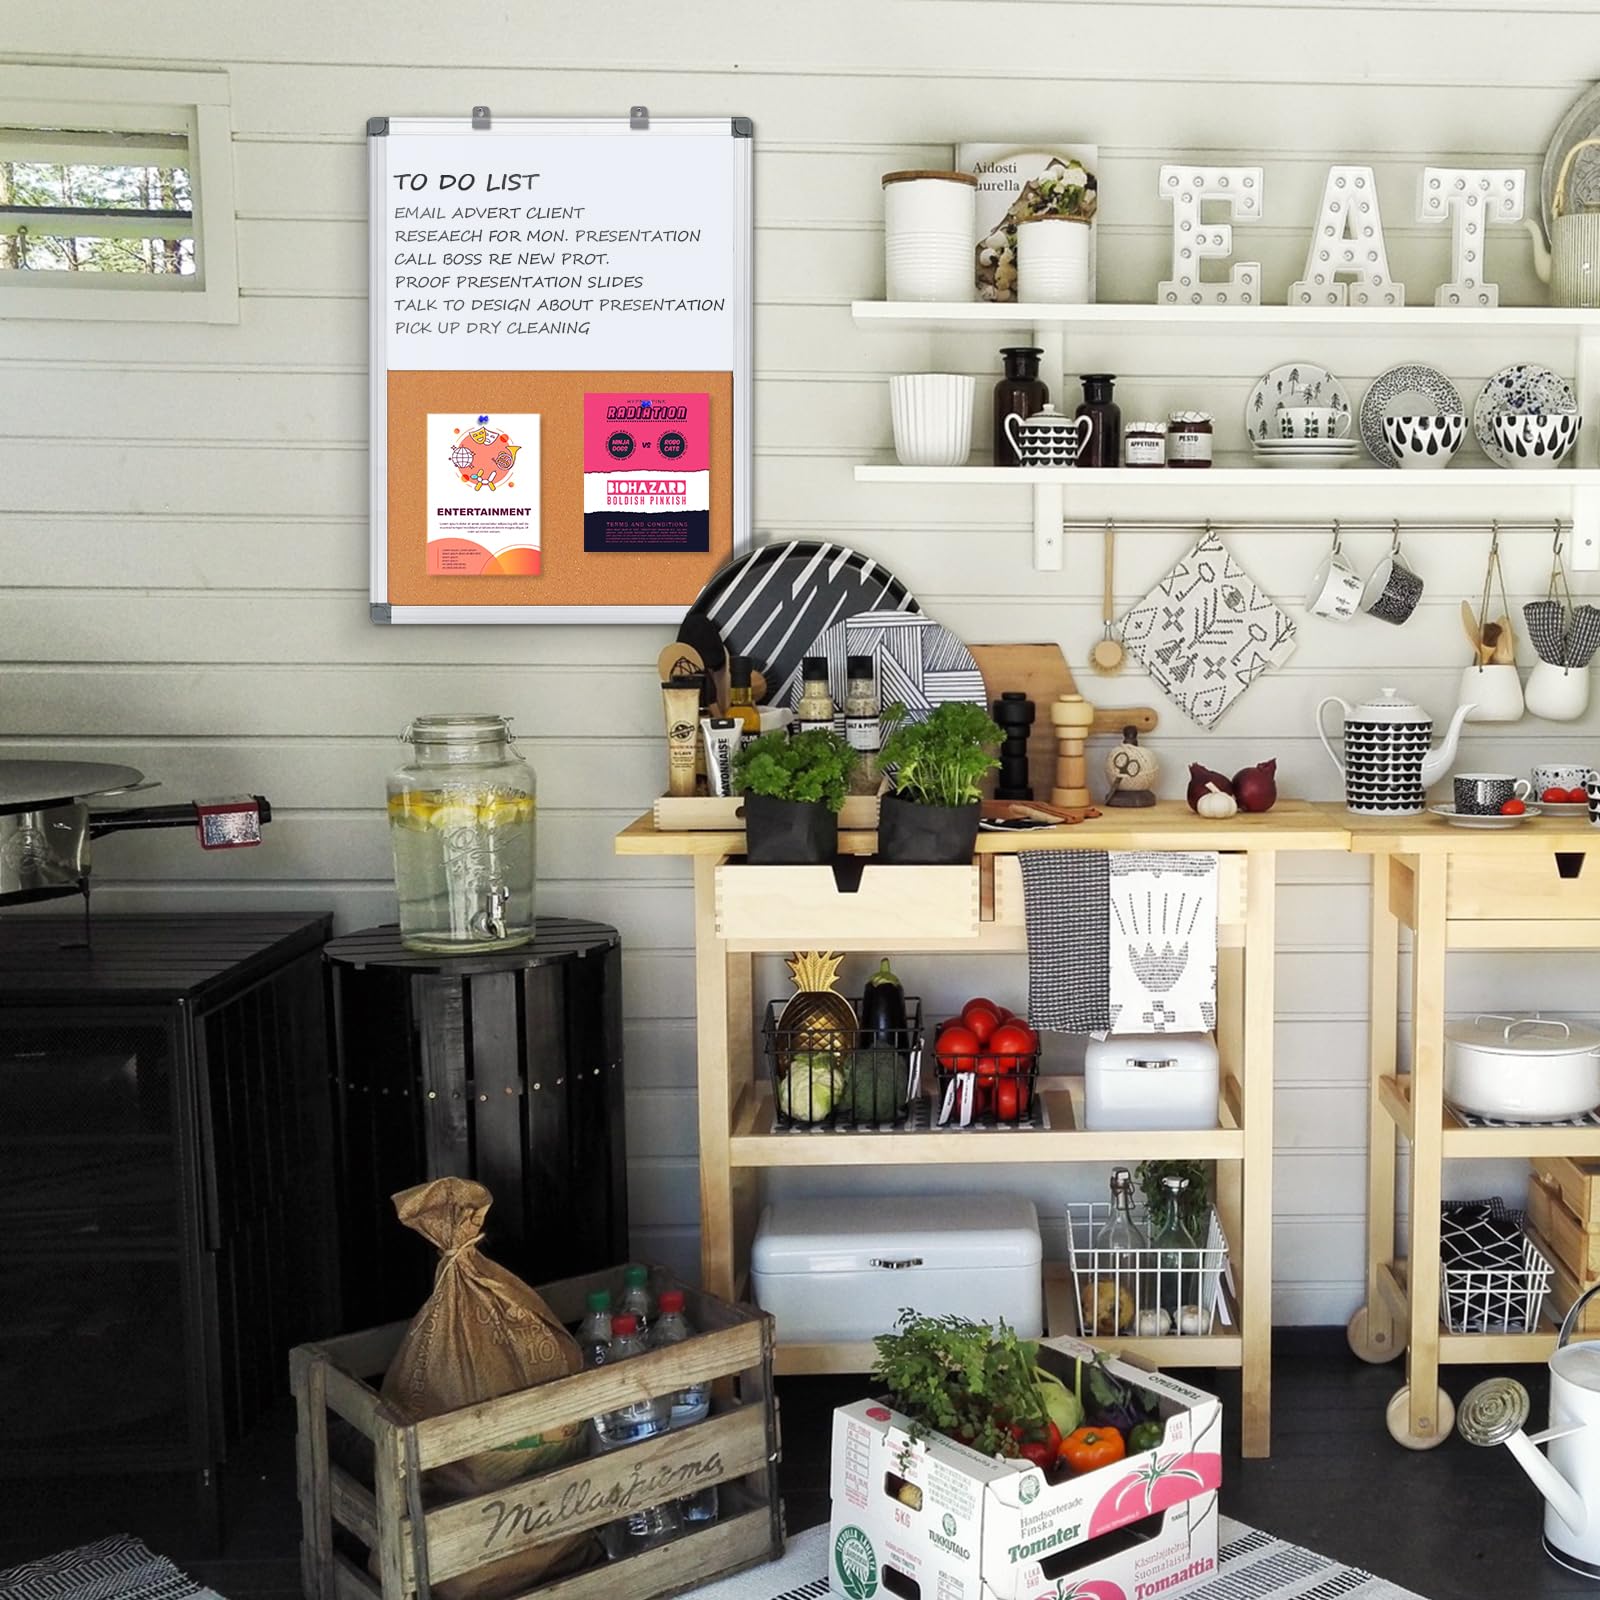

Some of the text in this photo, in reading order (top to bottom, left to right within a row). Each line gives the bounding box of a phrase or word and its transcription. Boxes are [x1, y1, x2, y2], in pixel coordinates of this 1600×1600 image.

[973, 161, 1017, 174] Aidosti
[393, 173, 540, 192] TO DO LIST
[394, 206, 586, 219] EMAIL ADVERT CLIENT
[394, 228, 701, 243] RESEAECH FOR MON. PRESENTATION
[394, 252, 610, 266] CALL BOSS RE NEW PROT.
[395, 275, 644, 288] PROOF PRESENTATION SLIDES
[394, 297, 725, 312] TALK TO DESIGN ABOUT PRESENTATION
[395, 320, 591, 335] PICK UP DRY CLEANING
[607, 405, 687, 420] RADIATION
[1130, 440, 1159, 448] APPETIZER
[1178, 434, 1199, 442] PESTO
[607, 481, 687, 494] BIOHAZARD
[607, 496, 687, 506] BOLDISH PINKISH
[437, 507, 531, 516] ENTERTAINMENT
[1020, 1497, 1083, 1528] Handsorterade
[1020, 1519, 1054, 1539] Finska
[1008, 1523, 1081, 1564] Tomater
[1134, 1557, 1214, 1600] Tomaattia
